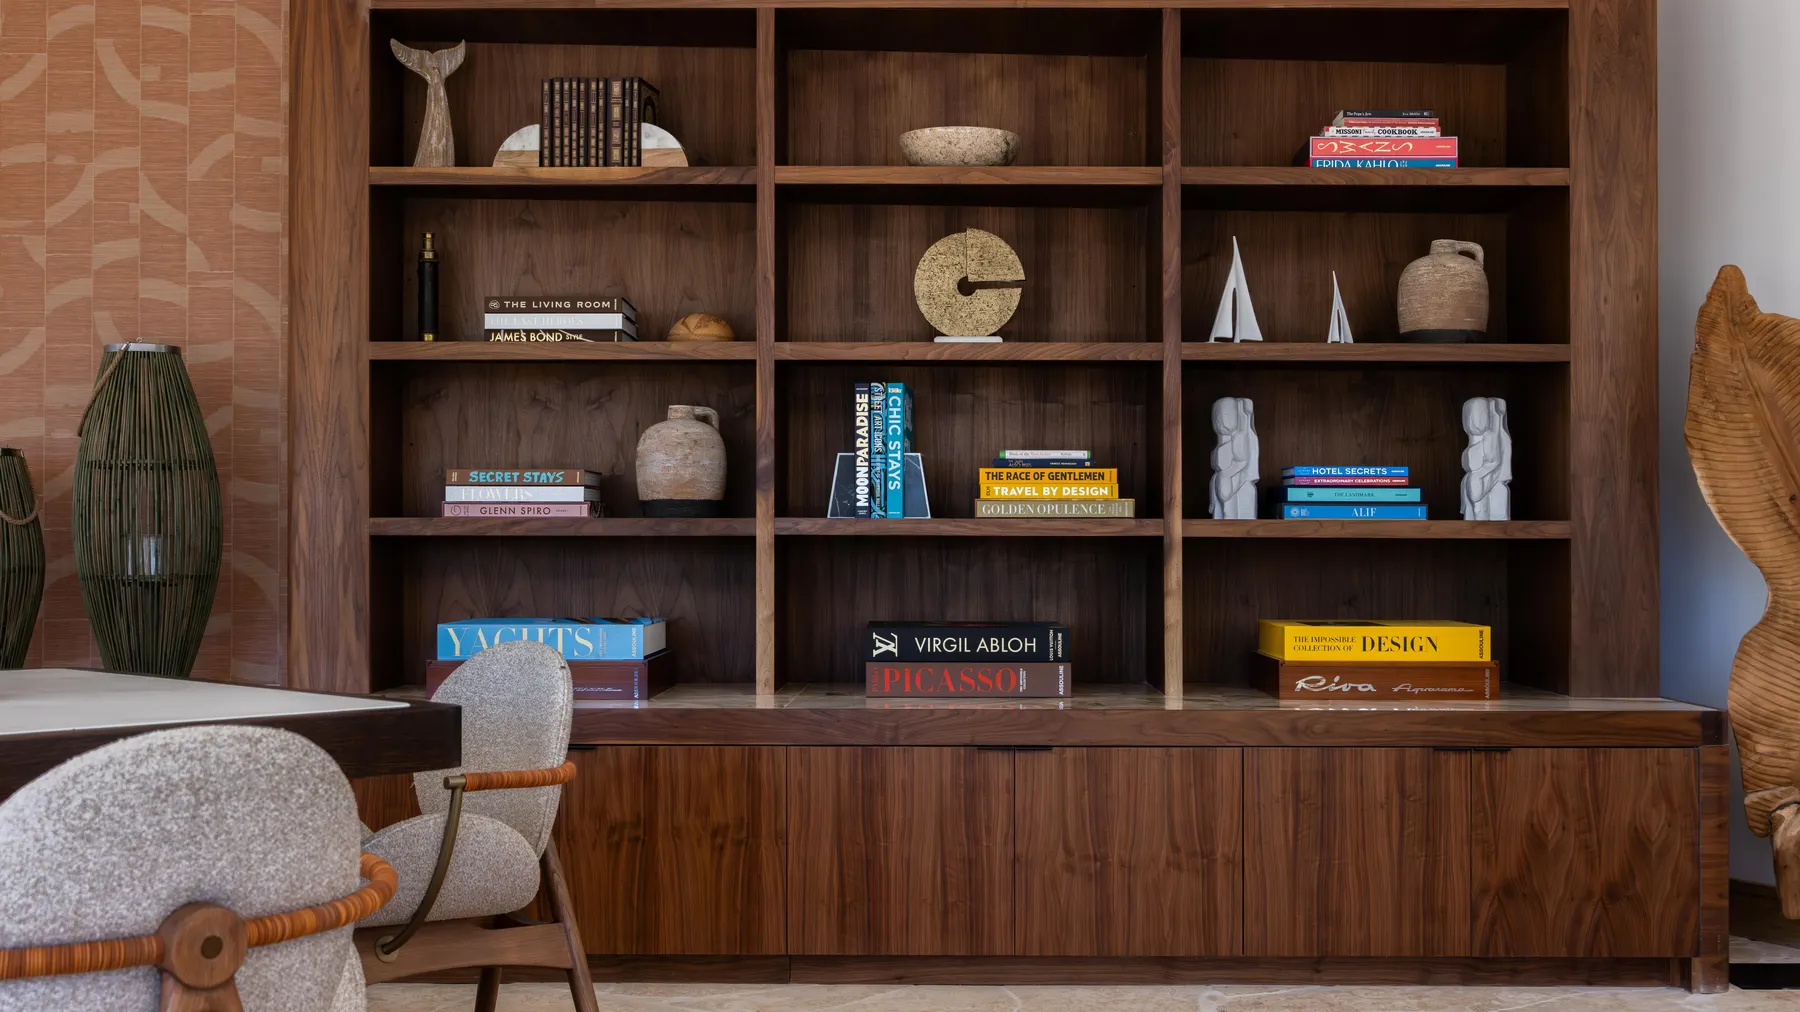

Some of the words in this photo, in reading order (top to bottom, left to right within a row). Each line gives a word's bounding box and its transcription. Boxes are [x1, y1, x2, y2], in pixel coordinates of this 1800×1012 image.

[489, 332, 527, 342] JAMES
[530, 332, 563, 342] BOND
[874, 387, 883, 414] STREET
[874, 415, 883, 429] ART
[888, 396, 902, 436] CHIC
[874, 431, 883, 453] ICONS
[888, 440, 902, 490] STAYS
[469, 471, 520, 483] SECRET
[523, 471, 565, 483] STAYS
[985, 472, 1003, 480] THE
[1006, 472, 1030, 480] RACE
[1033, 472, 1045, 480] OF
[1048, 472, 1105, 480] GENTLEMEN
[461, 488, 533, 501] FLOWERS
[993, 487, 1039, 496] TRAVEL
[1043, 487, 1059, 496] BY
[1062, 487, 1109, 496] DESIGN
[480, 507, 516, 515] GLENN
[520, 507, 551, 515] SPIRO
[982, 504, 1034, 515] GOLDEN
[1036, 504, 1106, 515] OPULENCE
[1352, 508, 1377, 517] ALIF
[915, 637, 971, 653] VIRGIL
[976, 637, 1036, 653] ABLOH
[1361, 635, 1439, 653] DESIGN
[883, 667, 1017, 693] PICASSO
[1294, 675, 1377, 692] Riva
[1392, 683, 1474, 694] Aquarama
